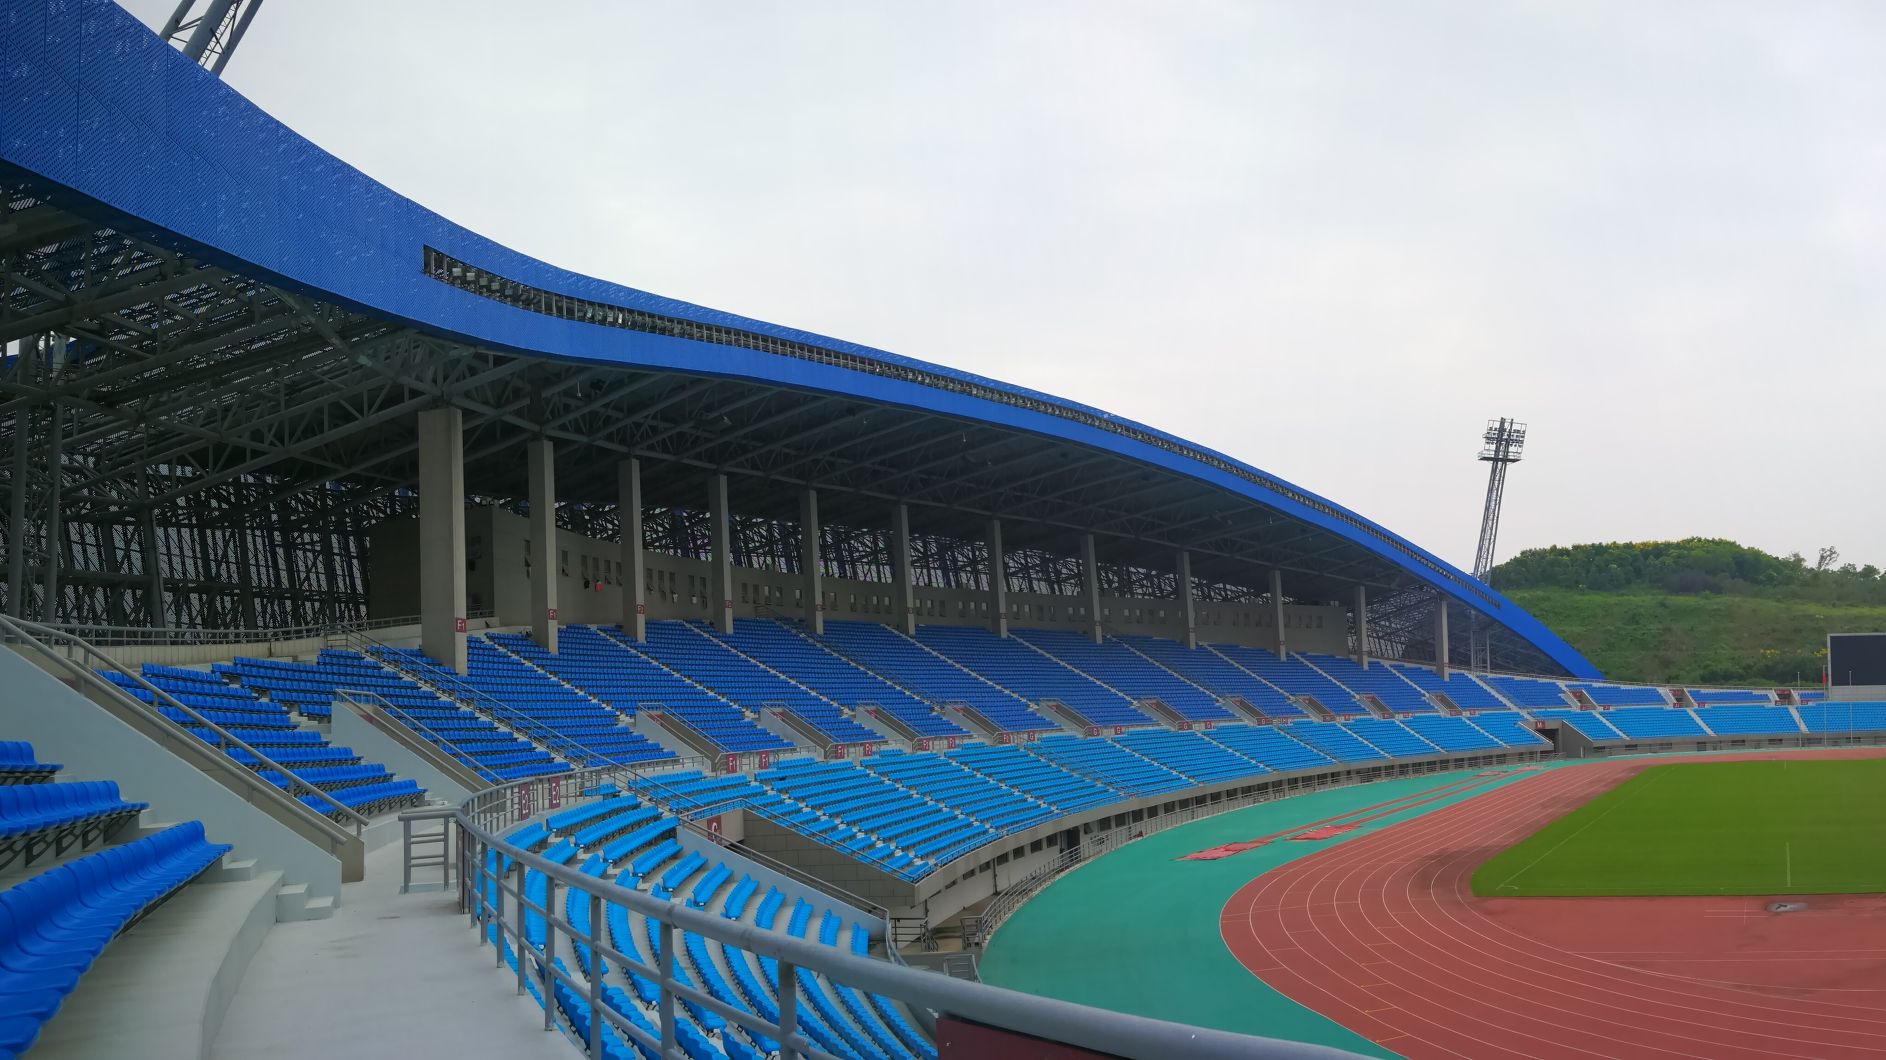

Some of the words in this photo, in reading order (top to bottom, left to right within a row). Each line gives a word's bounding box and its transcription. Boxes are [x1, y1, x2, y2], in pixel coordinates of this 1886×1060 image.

[549, 609, 556, 619] F1
[457, 619, 465, 630] F1
[838, 745, 844, 758] F1
[729, 757, 736, 771] F1
[762, 754, 768, 768] F1
[552, 783, 560, 804] E2
[522, 790, 529, 814] E2
